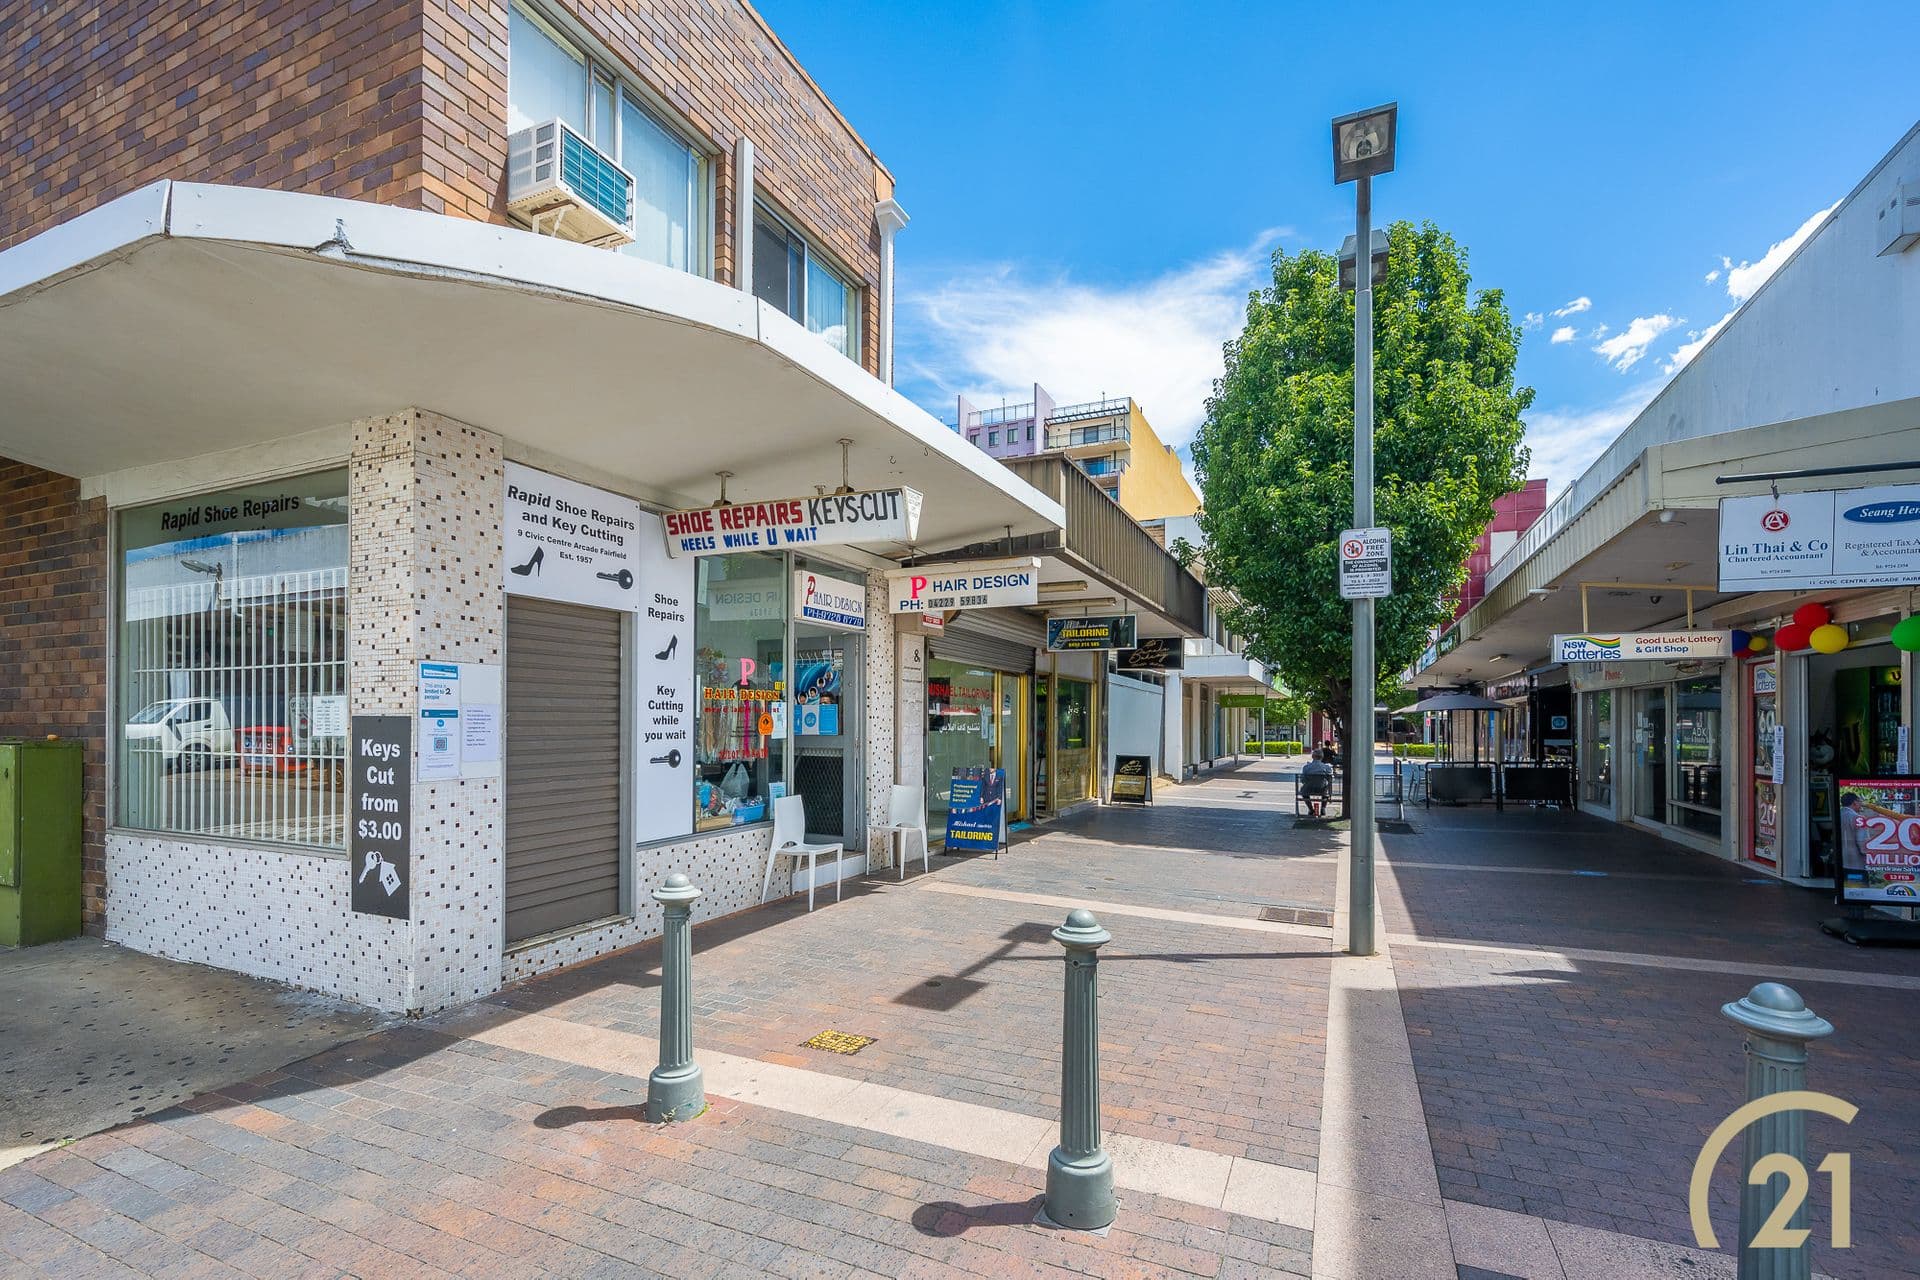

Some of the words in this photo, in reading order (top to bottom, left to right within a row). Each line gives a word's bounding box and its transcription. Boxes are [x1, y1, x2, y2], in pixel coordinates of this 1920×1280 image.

[161, 506, 200, 531] Rapid
[204, 503, 239, 523] Shoe
[243, 494, 300, 519] Repairs
[507, 485, 552, 508] Rapid
[555, 499, 587, 518] Shoe
[591, 509, 635, 531] Repairs
[1859, 507, 1894, 518] Seang
[666, 510, 714, 536] SHOE
[719, 500, 803, 530] REPAIRS
[522, 511, 548, 526] and
[552, 516, 577, 535] Key
[581, 524, 624, 546] Cutting
[517, 529, 523, 537] 9
[525, 531, 545, 542] Civic
[547, 536, 572, 548] Centre
[574, 542, 598, 554] Arcade
[600, 548, 627, 560] Fairfield
[681, 536, 716, 551] HEELS
[723, 532, 759, 548] WHILE
[766, 529, 778, 546] U
[784, 527, 818, 543] WAIT
[1362, 537, 1389, 545] ALCOHOL
[1844, 540, 1893, 550] Registered
[1895, 538, 1911, 548] Tax
[1725, 544, 1749, 556] Lin
[1752, 542, 1785, 554] Thai
[1789, 540, 1803, 552] &
[1808, 539, 1828, 551] Co
[1860, 549, 1869, 557] &
[560, 551, 574, 561] Est.
[576, 555, 593, 565] 1957
[1727, 554, 1772, 564] Chartered
[1773, 552, 1824, 561] Accountant
[910, 576, 928, 600] P
[933, 578, 967, 593] HAIR
[973, 573, 1030, 590] DESIGN
[654, 593, 679, 607] Shoe
[813, 591, 833, 608] HAIR
[834, 596, 863, 614] DESIGN
[899, 600, 924, 611] PH:
[648, 607, 685, 623] Repairs
[1061, 628, 1109, 639] TAILORING
[1635, 637, 1661, 645] Good
[1662, 636, 1687, 644] Luck
[1688, 635, 1723, 645] Lottery
[1562, 648, 1621, 660] Lotteries
[1645, 645, 1663, 653] Gift
[1664, 645, 1689, 654] Shop
[740, 657, 756, 686] P
[445, 687, 452, 695] 2
[657, 685, 676, 698] Key
[704, 687, 736, 700] HAIR
[740, 689, 780, 701] DESIGN
[648, 700, 684, 713] Cutting
[653, 715, 679, 725] while
[645, 731, 663, 743] you
[666, 730, 686, 740] wait
[361, 738, 401, 762] Keys
[366, 765, 395, 785] Cut
[361, 793, 399, 813] from
[1759, 803, 1775, 826] 20
[358, 818, 402, 841] $3.00
[950, 830, 994, 841] TAILORING
